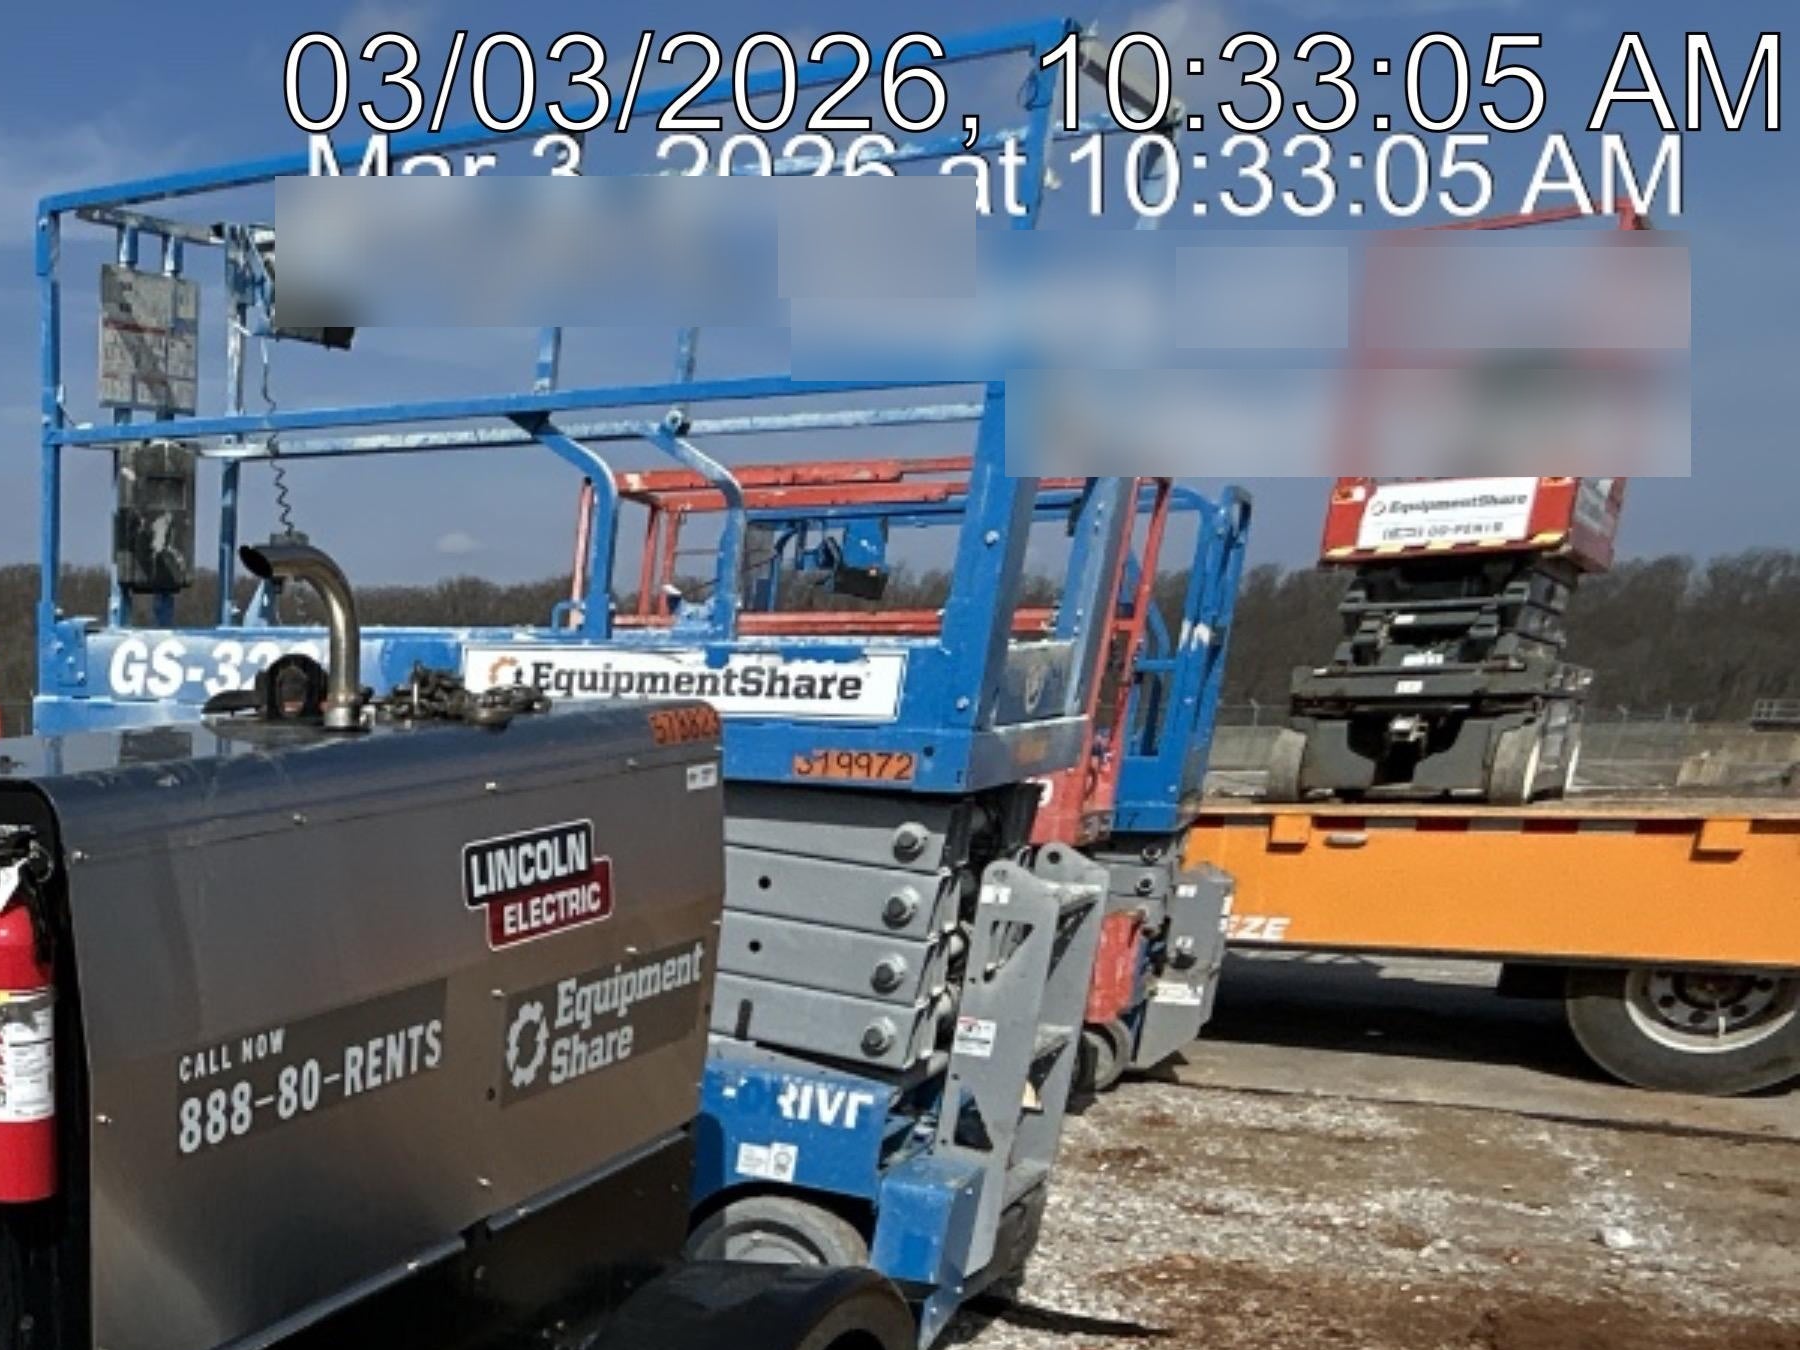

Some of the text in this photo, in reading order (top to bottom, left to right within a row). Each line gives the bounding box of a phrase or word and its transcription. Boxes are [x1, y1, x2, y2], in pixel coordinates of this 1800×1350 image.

[110, 639, 330, 697] GS-32
[532, 661, 863, 701] EquipmentShare
[470, 831, 588, 898] LINCOLN
[503, 882, 601, 936] ELECTRIC
[554, 942, 703, 1030] Equipment
[179, 1028, 286, 1083] CALL NOW
[549, 1024, 634, 1085] Share
[179, 1019, 442, 1153] 888-80-RENTS
